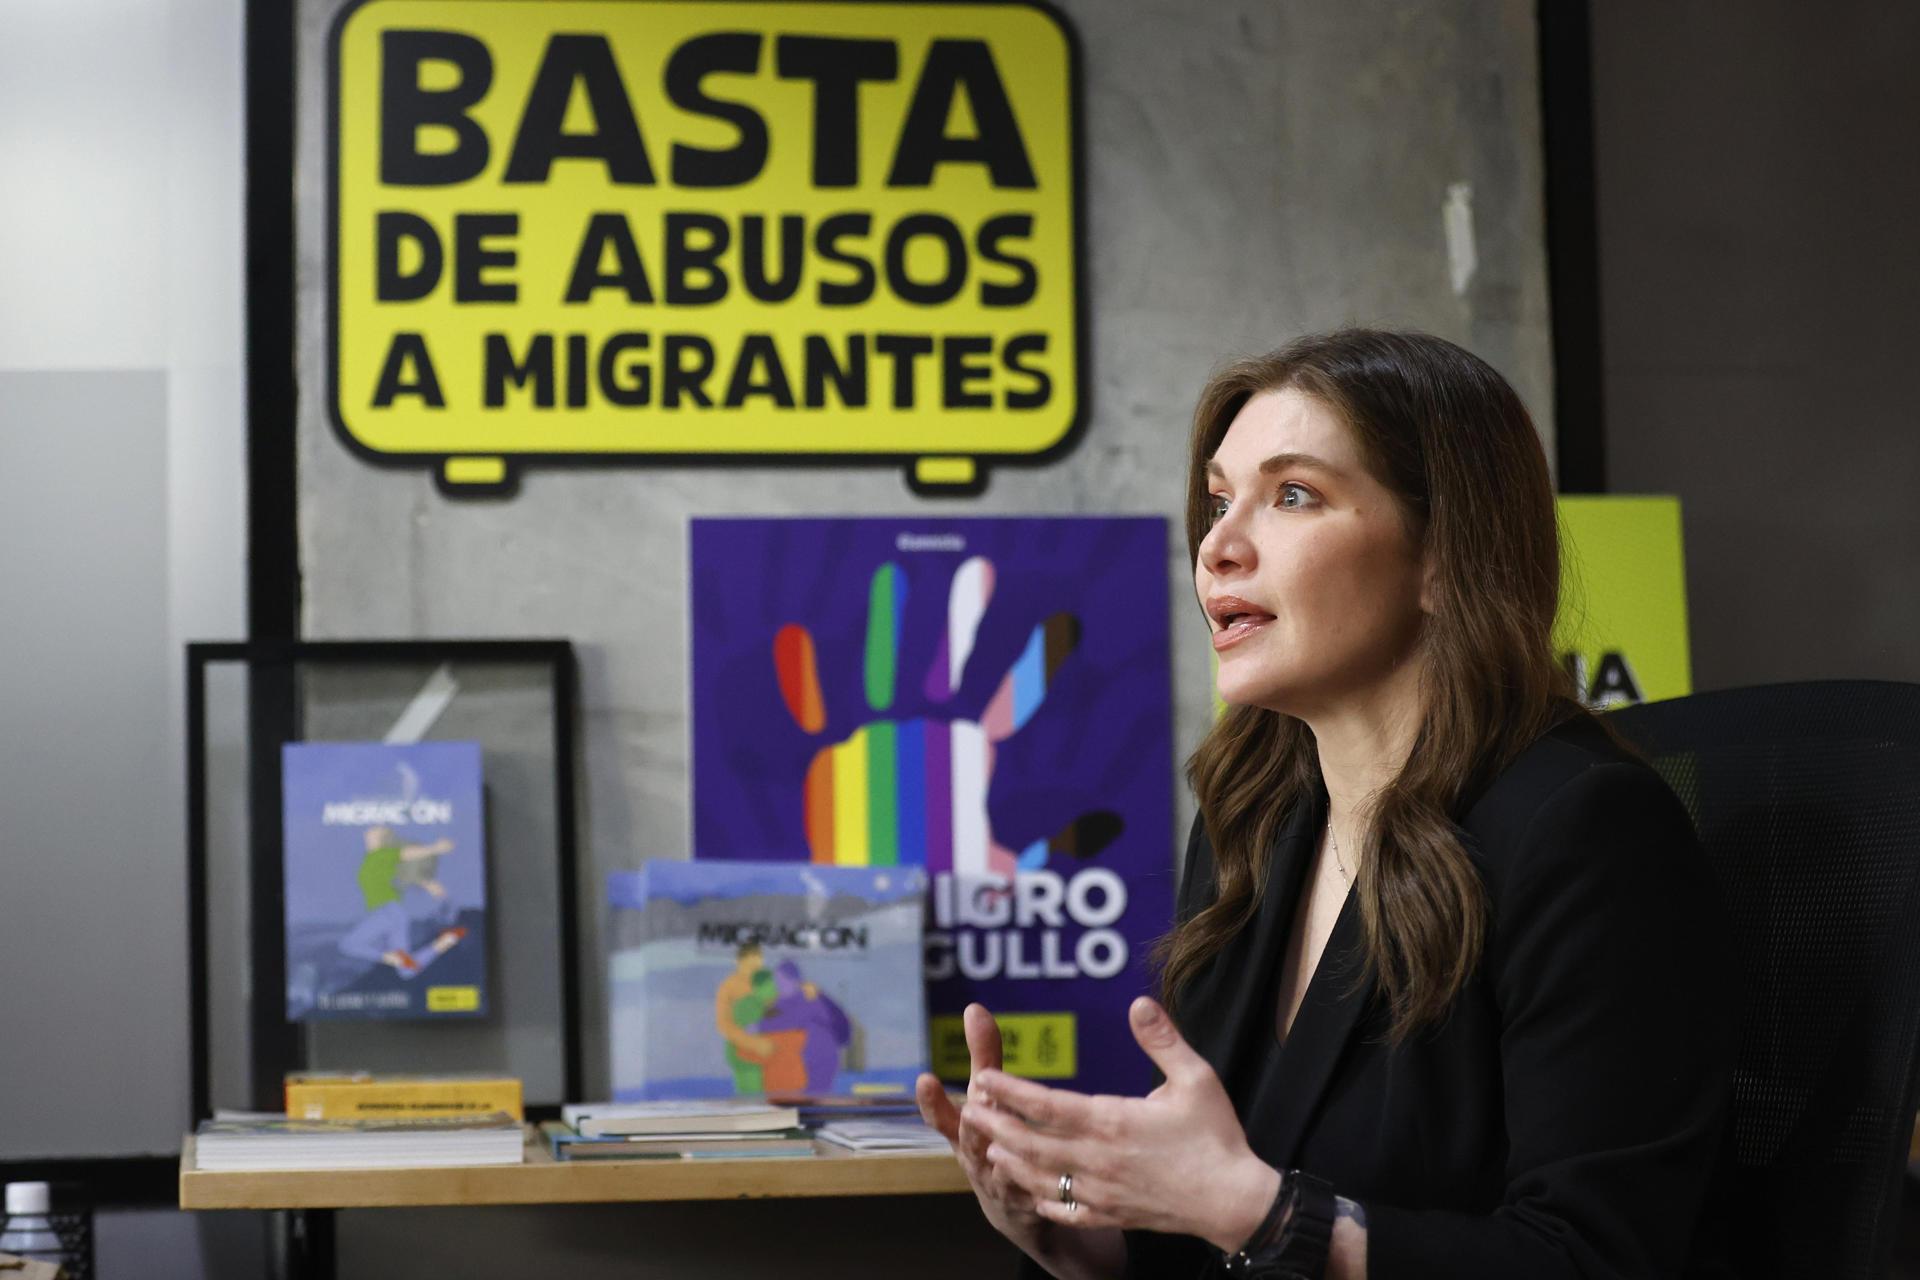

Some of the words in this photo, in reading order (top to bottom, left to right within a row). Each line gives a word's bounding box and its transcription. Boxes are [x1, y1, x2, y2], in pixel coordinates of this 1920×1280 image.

[378, 28, 1039, 190] BASTA
[375, 211, 520, 305] DE
[563, 211, 1040, 308] ABUSOS
[370, 332, 447, 410] A
[482, 332, 1053, 411] MIGRANTES
[934, 867, 1128, 929] IGRO
[924, 928, 1129, 981] GULLO
